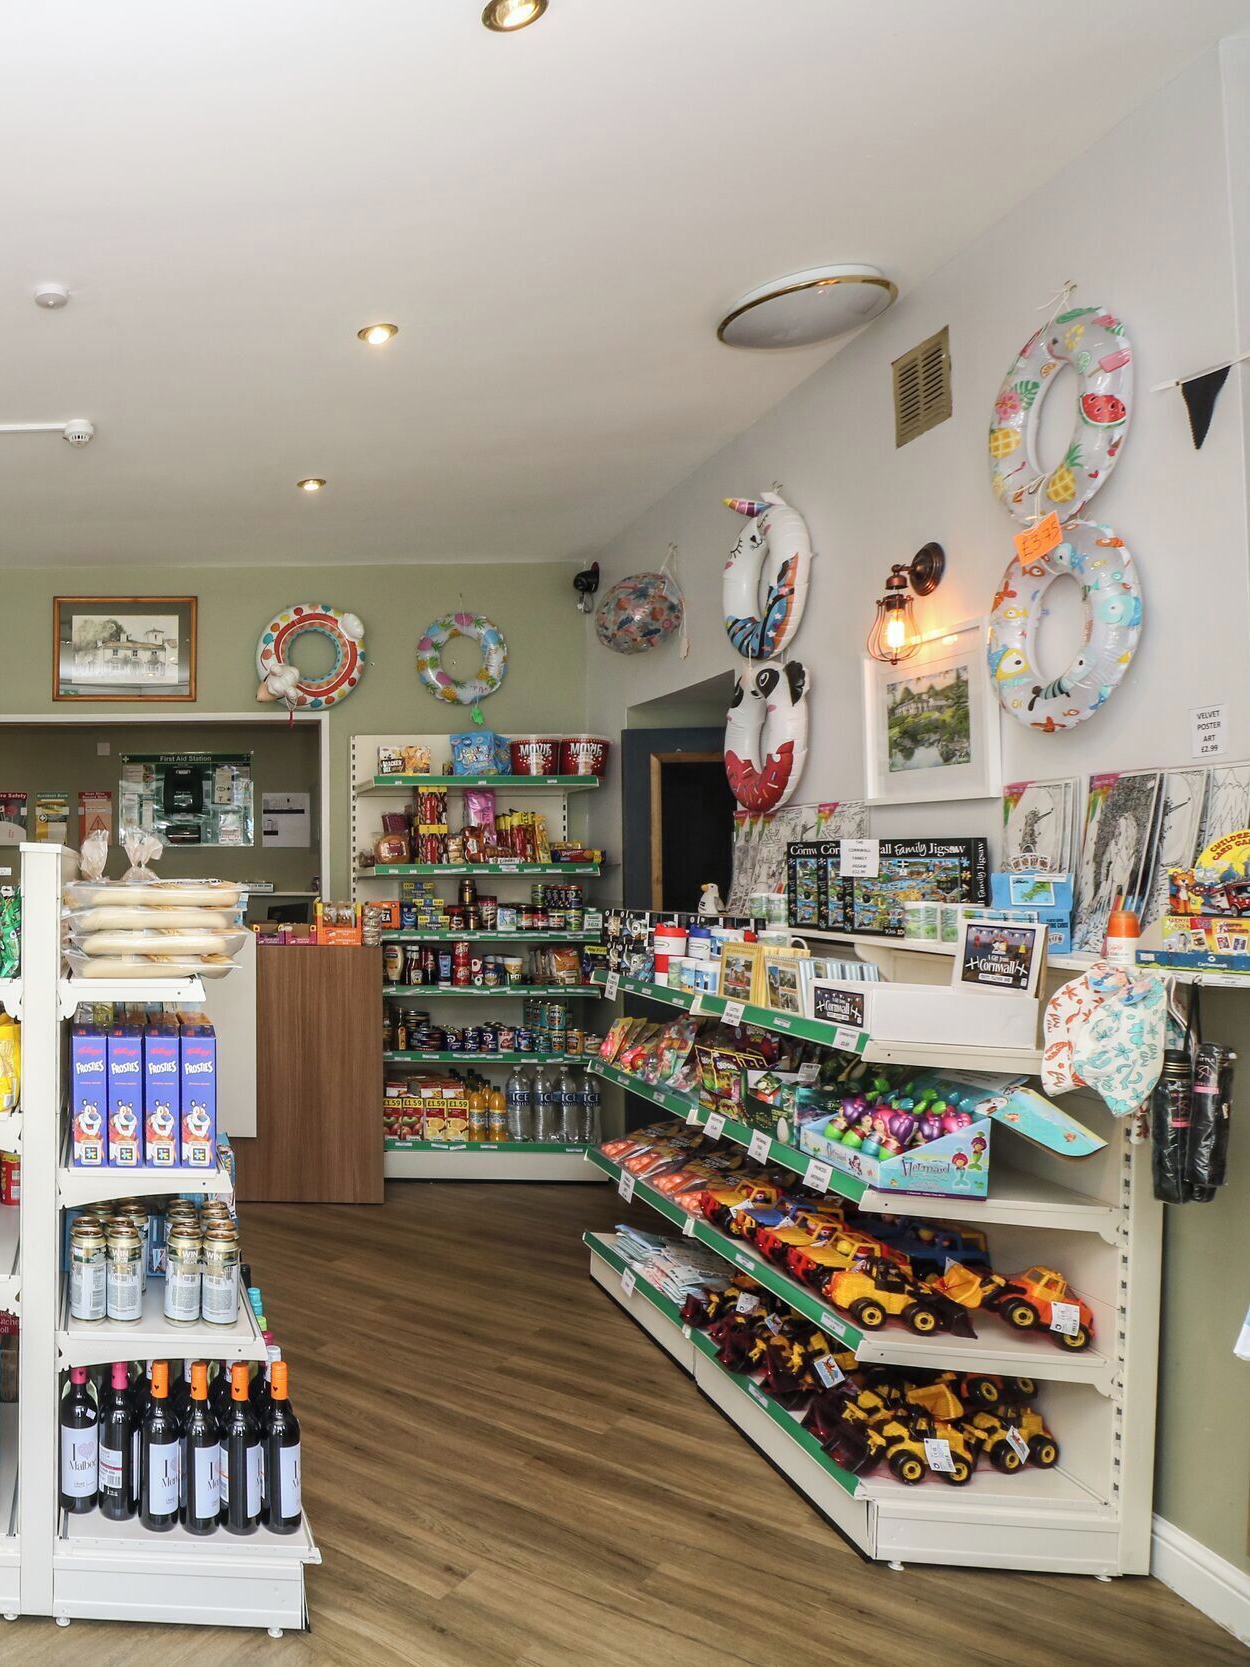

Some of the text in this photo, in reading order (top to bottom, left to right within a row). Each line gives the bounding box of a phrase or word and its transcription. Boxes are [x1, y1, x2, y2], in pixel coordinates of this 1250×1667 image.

[1197, 710, 1220, 720] VELVET
[1197, 721, 1221, 731] POSTER
[1201, 745, 1218, 753] £2.99
[895, 842, 927, 857] Family
[929, 843, 966, 857] Jigsaw
[977, 842, 985, 871] Jigsaw
[1213, 845, 1233, 861] CARD
[980, 959, 1016, 974] Cornwall
[76, 1060, 104, 1074] FROSTIES
[111, 1061, 139, 1075] FROSTIES
[148, 1061, 176, 1075] FROSTIES
[184, 1061, 213, 1075] FROSTIES
[902, 1157, 950, 1177] Mermaid
[112, 1249, 128, 1258] WIN
[182, 1250, 198, 1258] WIN
[206, 1252, 223, 1261] WIN
